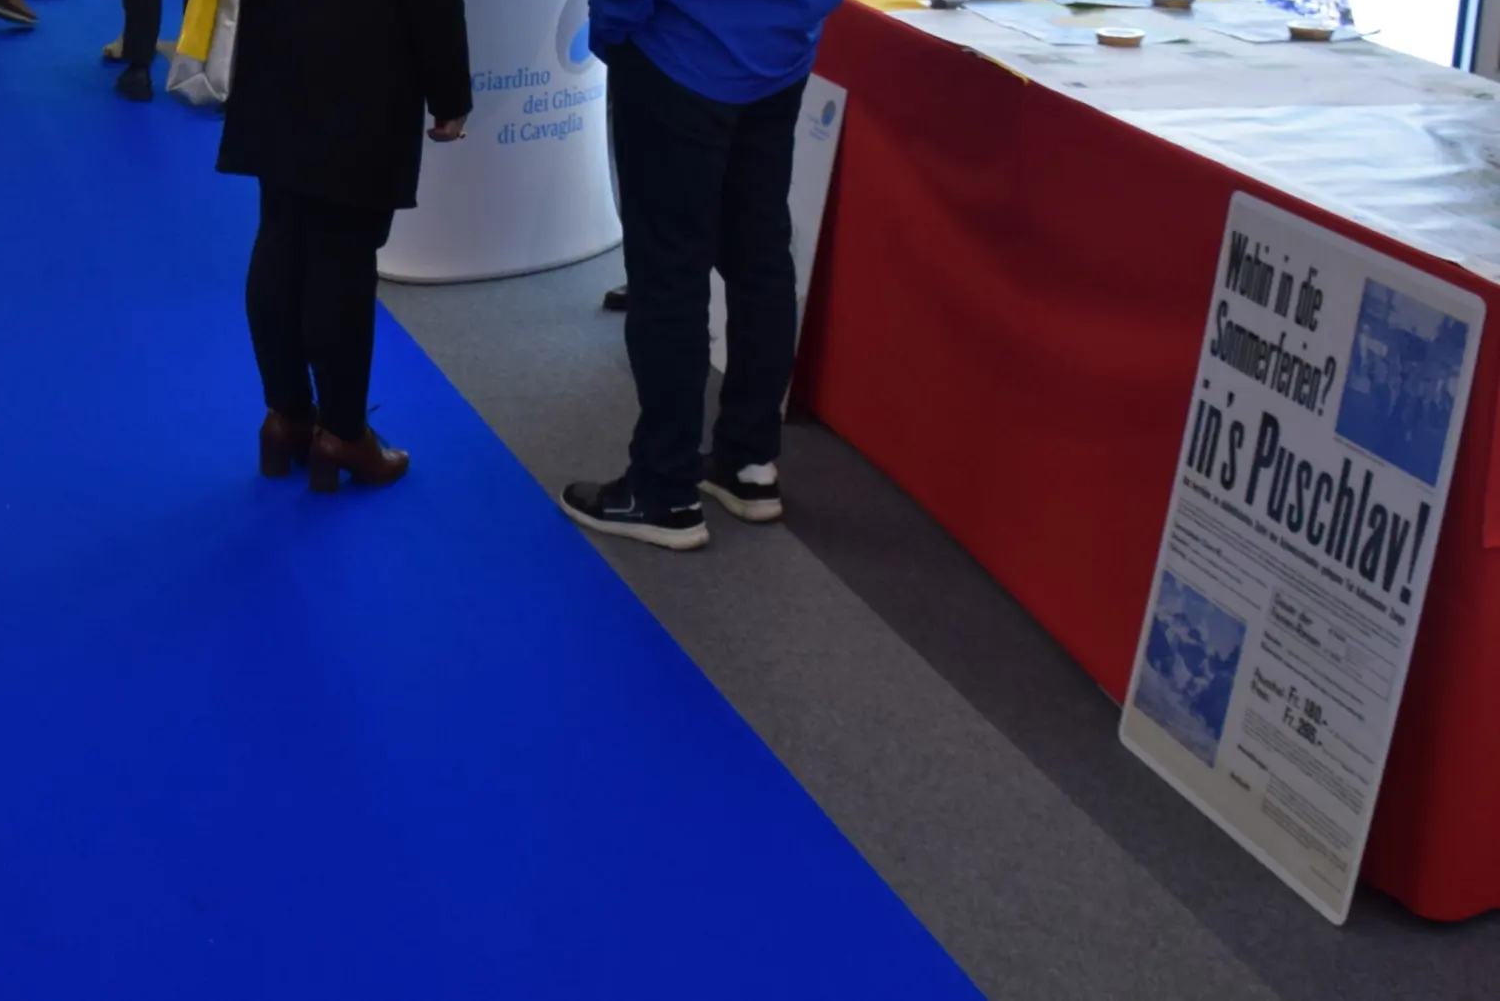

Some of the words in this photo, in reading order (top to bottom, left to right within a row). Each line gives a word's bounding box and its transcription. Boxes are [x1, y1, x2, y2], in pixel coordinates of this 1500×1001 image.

[470, 66, 551, 93] Giardino
[522, 91, 549, 115] dei
[497, 122, 516, 145] di
[520, 112, 584, 142] Cavaglia
[1225, 230, 1275, 309] Wohin
[1273, 254, 1294, 318] in
[1294, 264, 1324, 333] die
[1209, 299, 1337, 417] Sommerferien?
[1186, 379, 1246, 492] in's
[1244, 409, 1431, 606] Puschlav!
